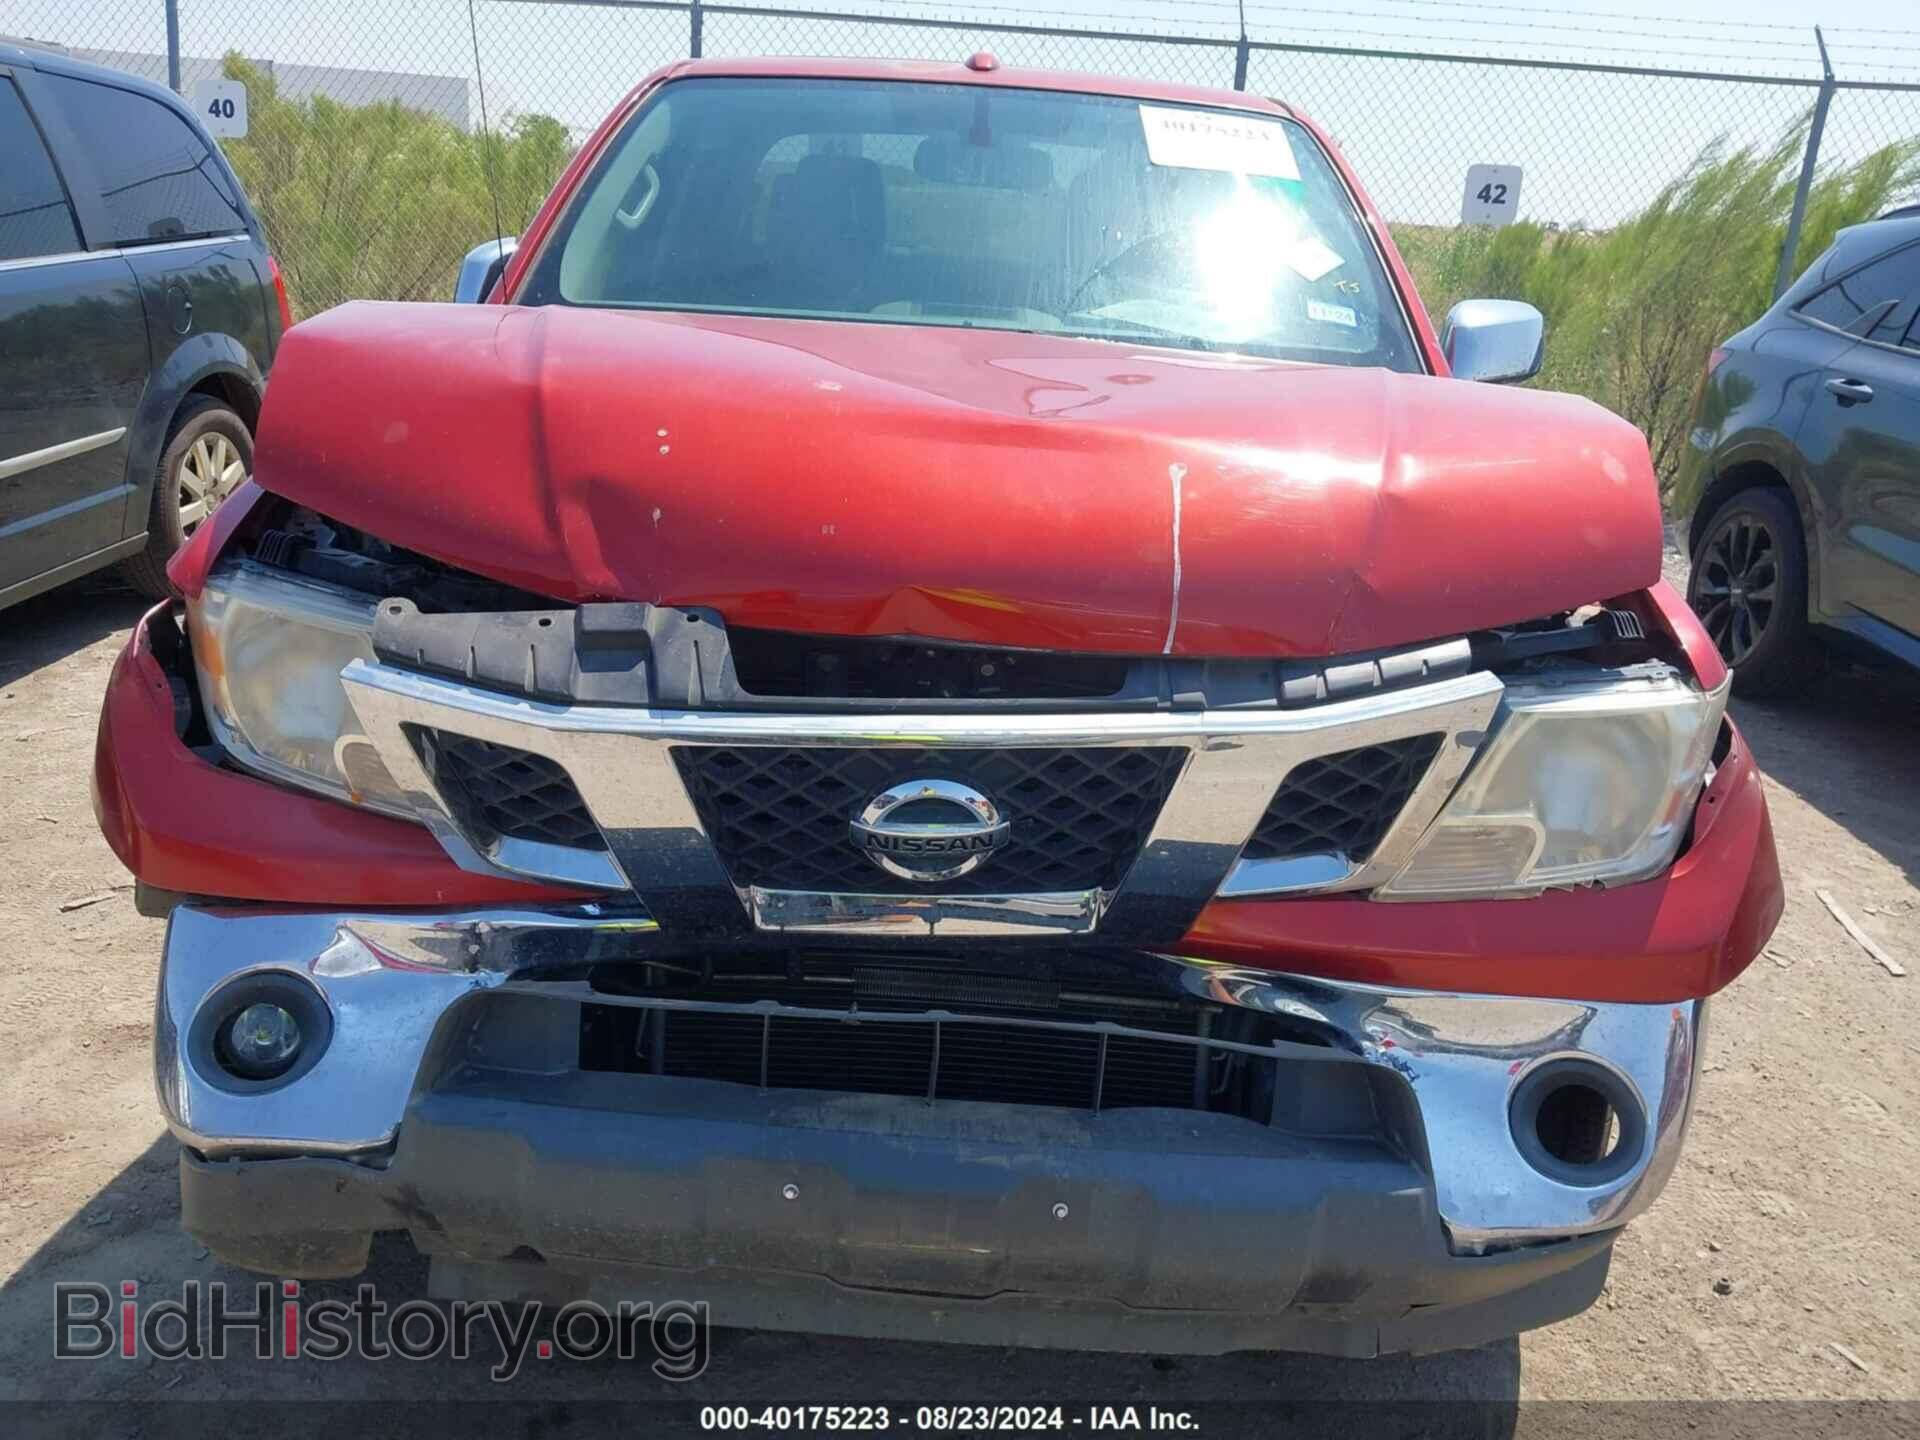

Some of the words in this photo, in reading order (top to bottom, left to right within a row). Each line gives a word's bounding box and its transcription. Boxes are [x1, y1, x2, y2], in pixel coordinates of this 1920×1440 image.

[208, 98, 235, 119] 40
[1476, 183, 1508, 205] 42
[865, 833, 993, 852] NISSAN
